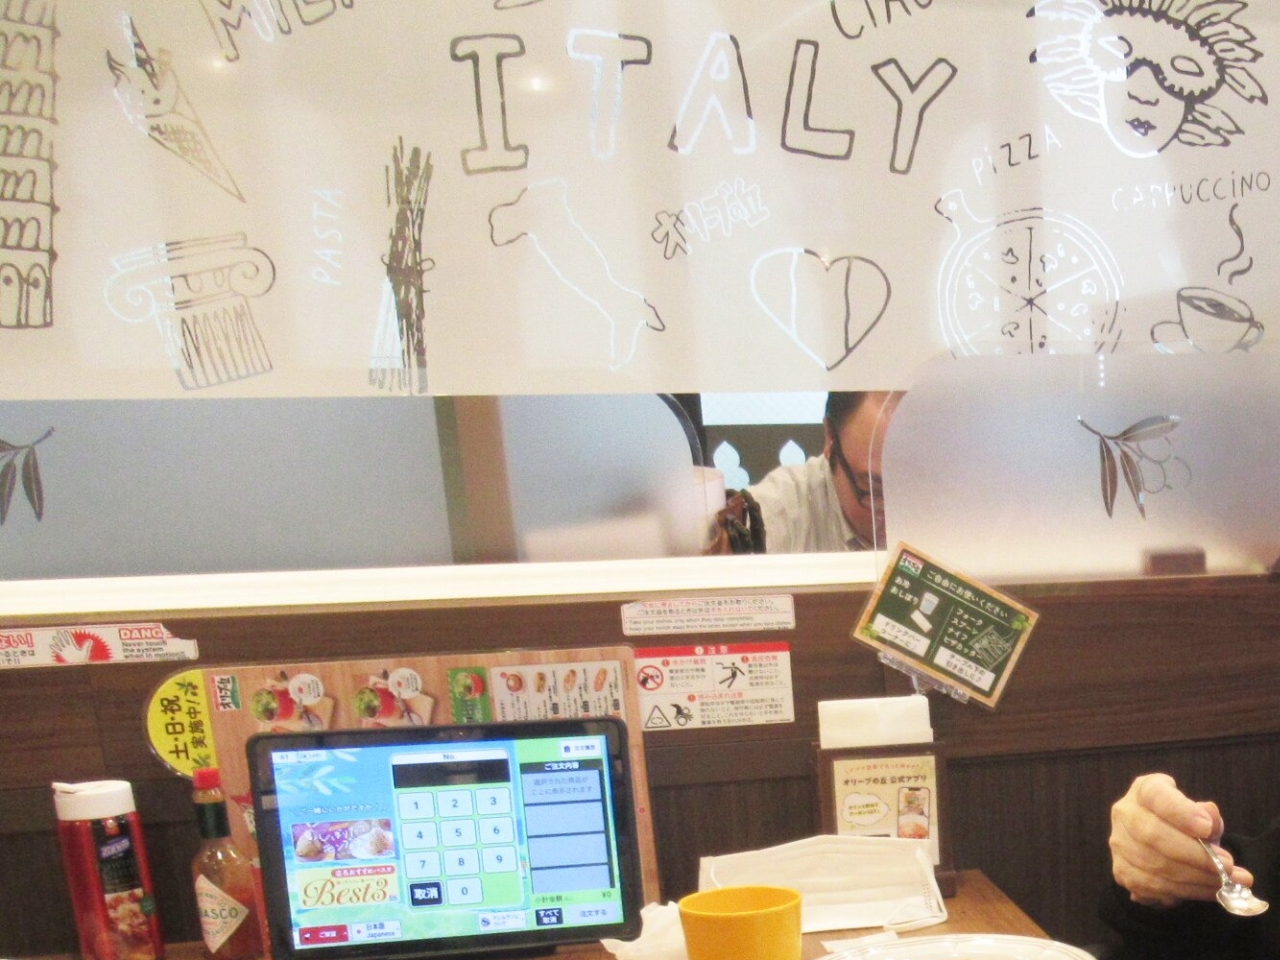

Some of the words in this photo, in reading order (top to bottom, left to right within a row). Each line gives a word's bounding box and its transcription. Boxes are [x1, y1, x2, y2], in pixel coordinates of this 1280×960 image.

[450, 28, 958, 175] ITALY
[311, 188, 343, 286] PASTA
[889, 584, 920, 606] おしぼり
[925, 569, 1009, 619] ご自由にお使いください
[955, 608, 983, 627] フォーク
[946, 626, 967, 641] ナイフ
[950, 617, 979, 636] スプーン
[0, 650, 36, 658] るときは
[544, 762, 579, 770] ご注文内容
[413, 886, 439, 900] 取消
[538, 909, 560, 917] すべて
[581, 909, 607, 917] 注文する
[366, 922, 385, 930] 日本語
